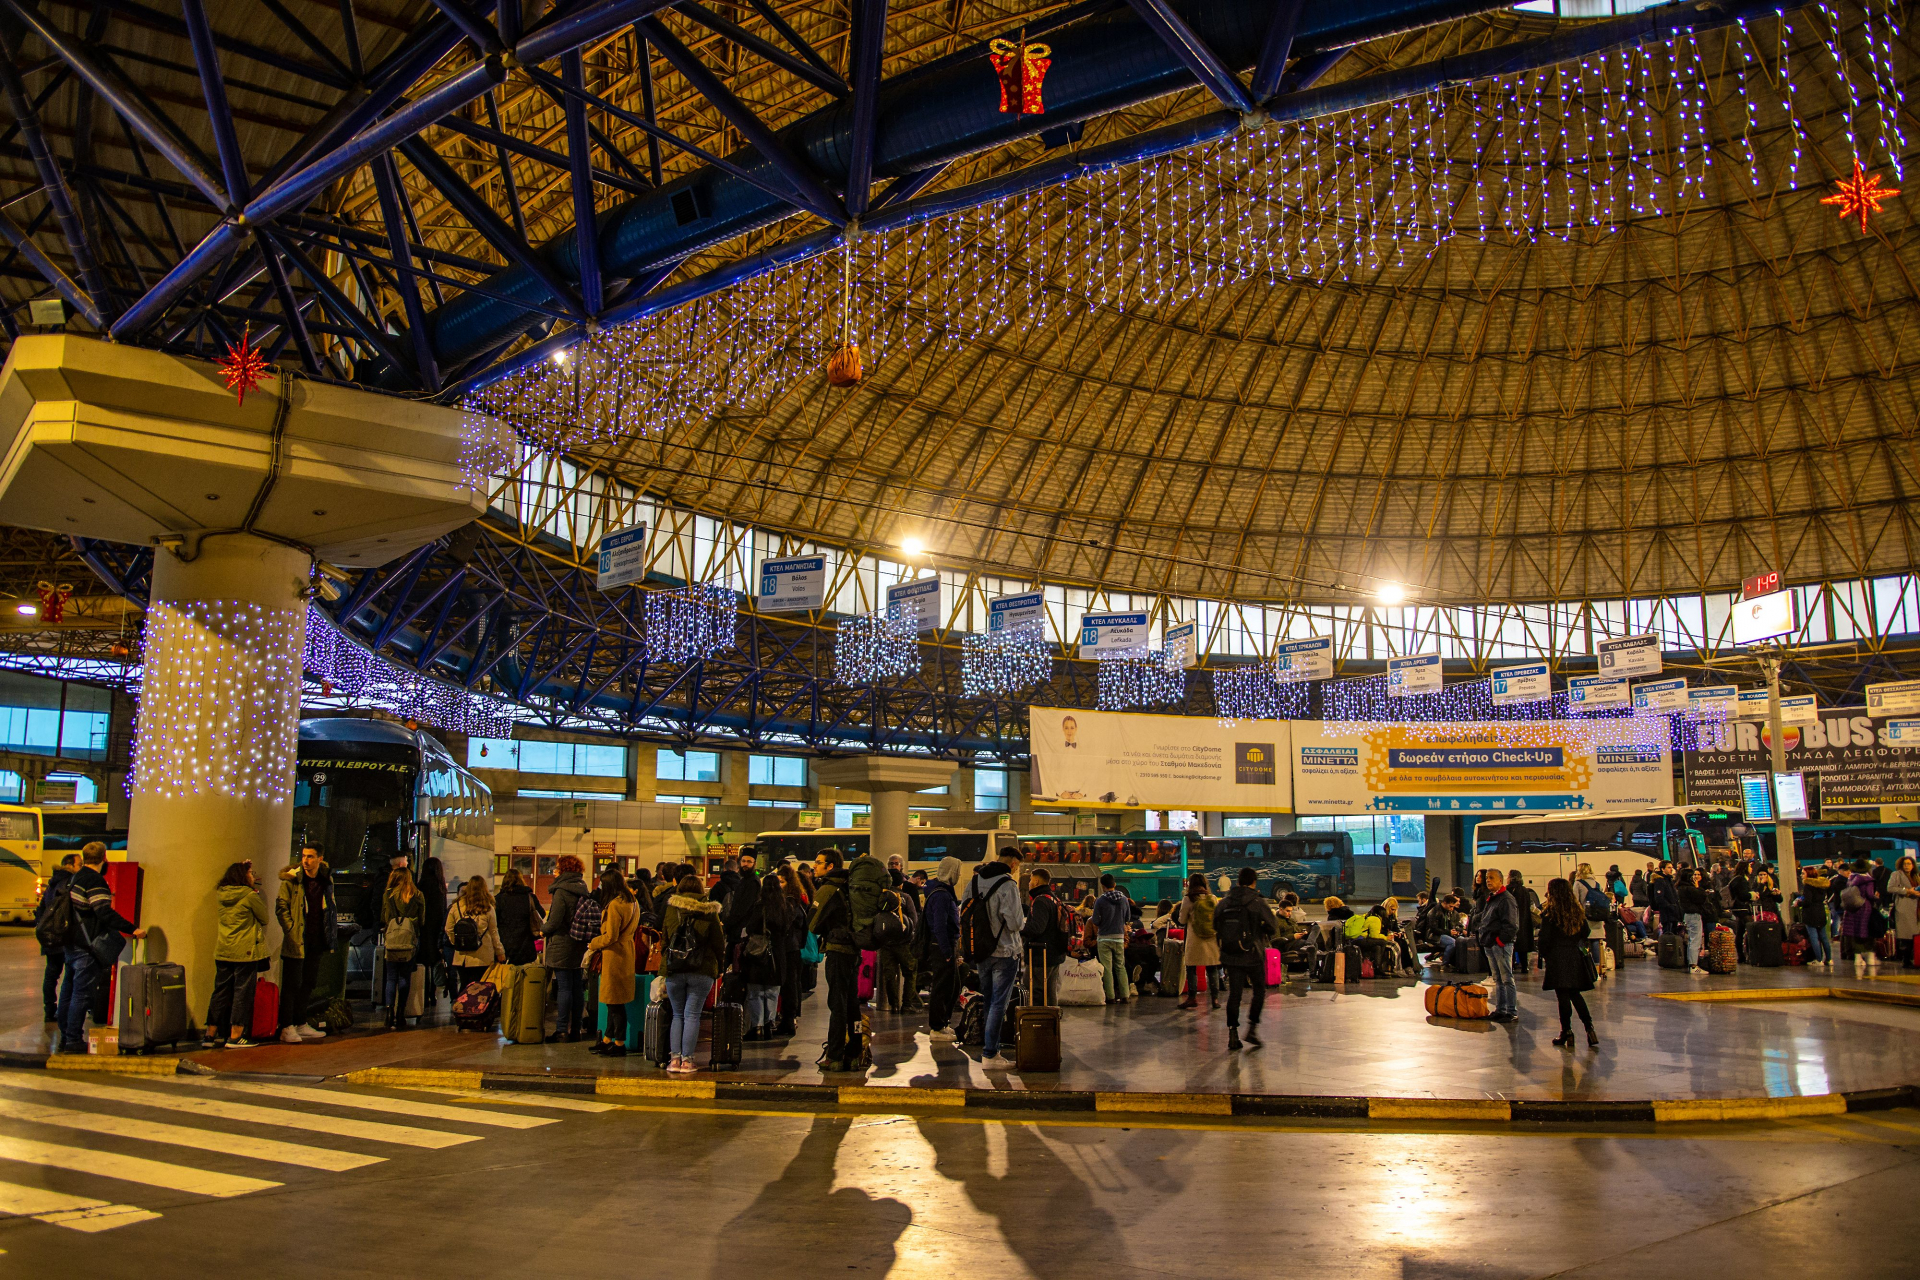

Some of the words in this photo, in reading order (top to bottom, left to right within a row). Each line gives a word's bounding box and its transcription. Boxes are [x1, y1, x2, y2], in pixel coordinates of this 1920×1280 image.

[601, 554, 610, 570] 18
[784, 562, 816, 571] ΜΑΓΝΗΣΙΑΣ
[763, 578, 776, 594] 18
[1008, 598, 1038, 608] ΘΕΣΠΡΩΤΙΑΣ
[992, 614, 1003, 628] 18
[1084, 630, 1097, 643] 18
[1280, 656, 1290, 668] 17
[1604, 654, 1611, 666] 6
[1495, 682, 1506, 692] 17
[1690, 700, 1698, 710] 16
[1872, 696, 1878, 706] 7
[1890, 730, 1900, 738] 14
[1398, 752, 1445, 764] δωρεάν
[1448, 752, 1489, 764] ετήσιο
[1492, 752, 1553, 763] Check-Up
[1698, 754, 1757, 763] ΚΑΘΕΤΗ
[335, 761, 386, 770] Ν.ΕΒΡΟΥ
[386, 764, 408, 773] Α.Ε.
[1399, 773, 1412, 781] όλα
[1424, 774, 1462, 783] συμβόλαια
[1524, 773, 1565, 782] περιουσίας
[1832, 784, 1880, 792] ΑΜΜΟΒΟΛΕΣ
